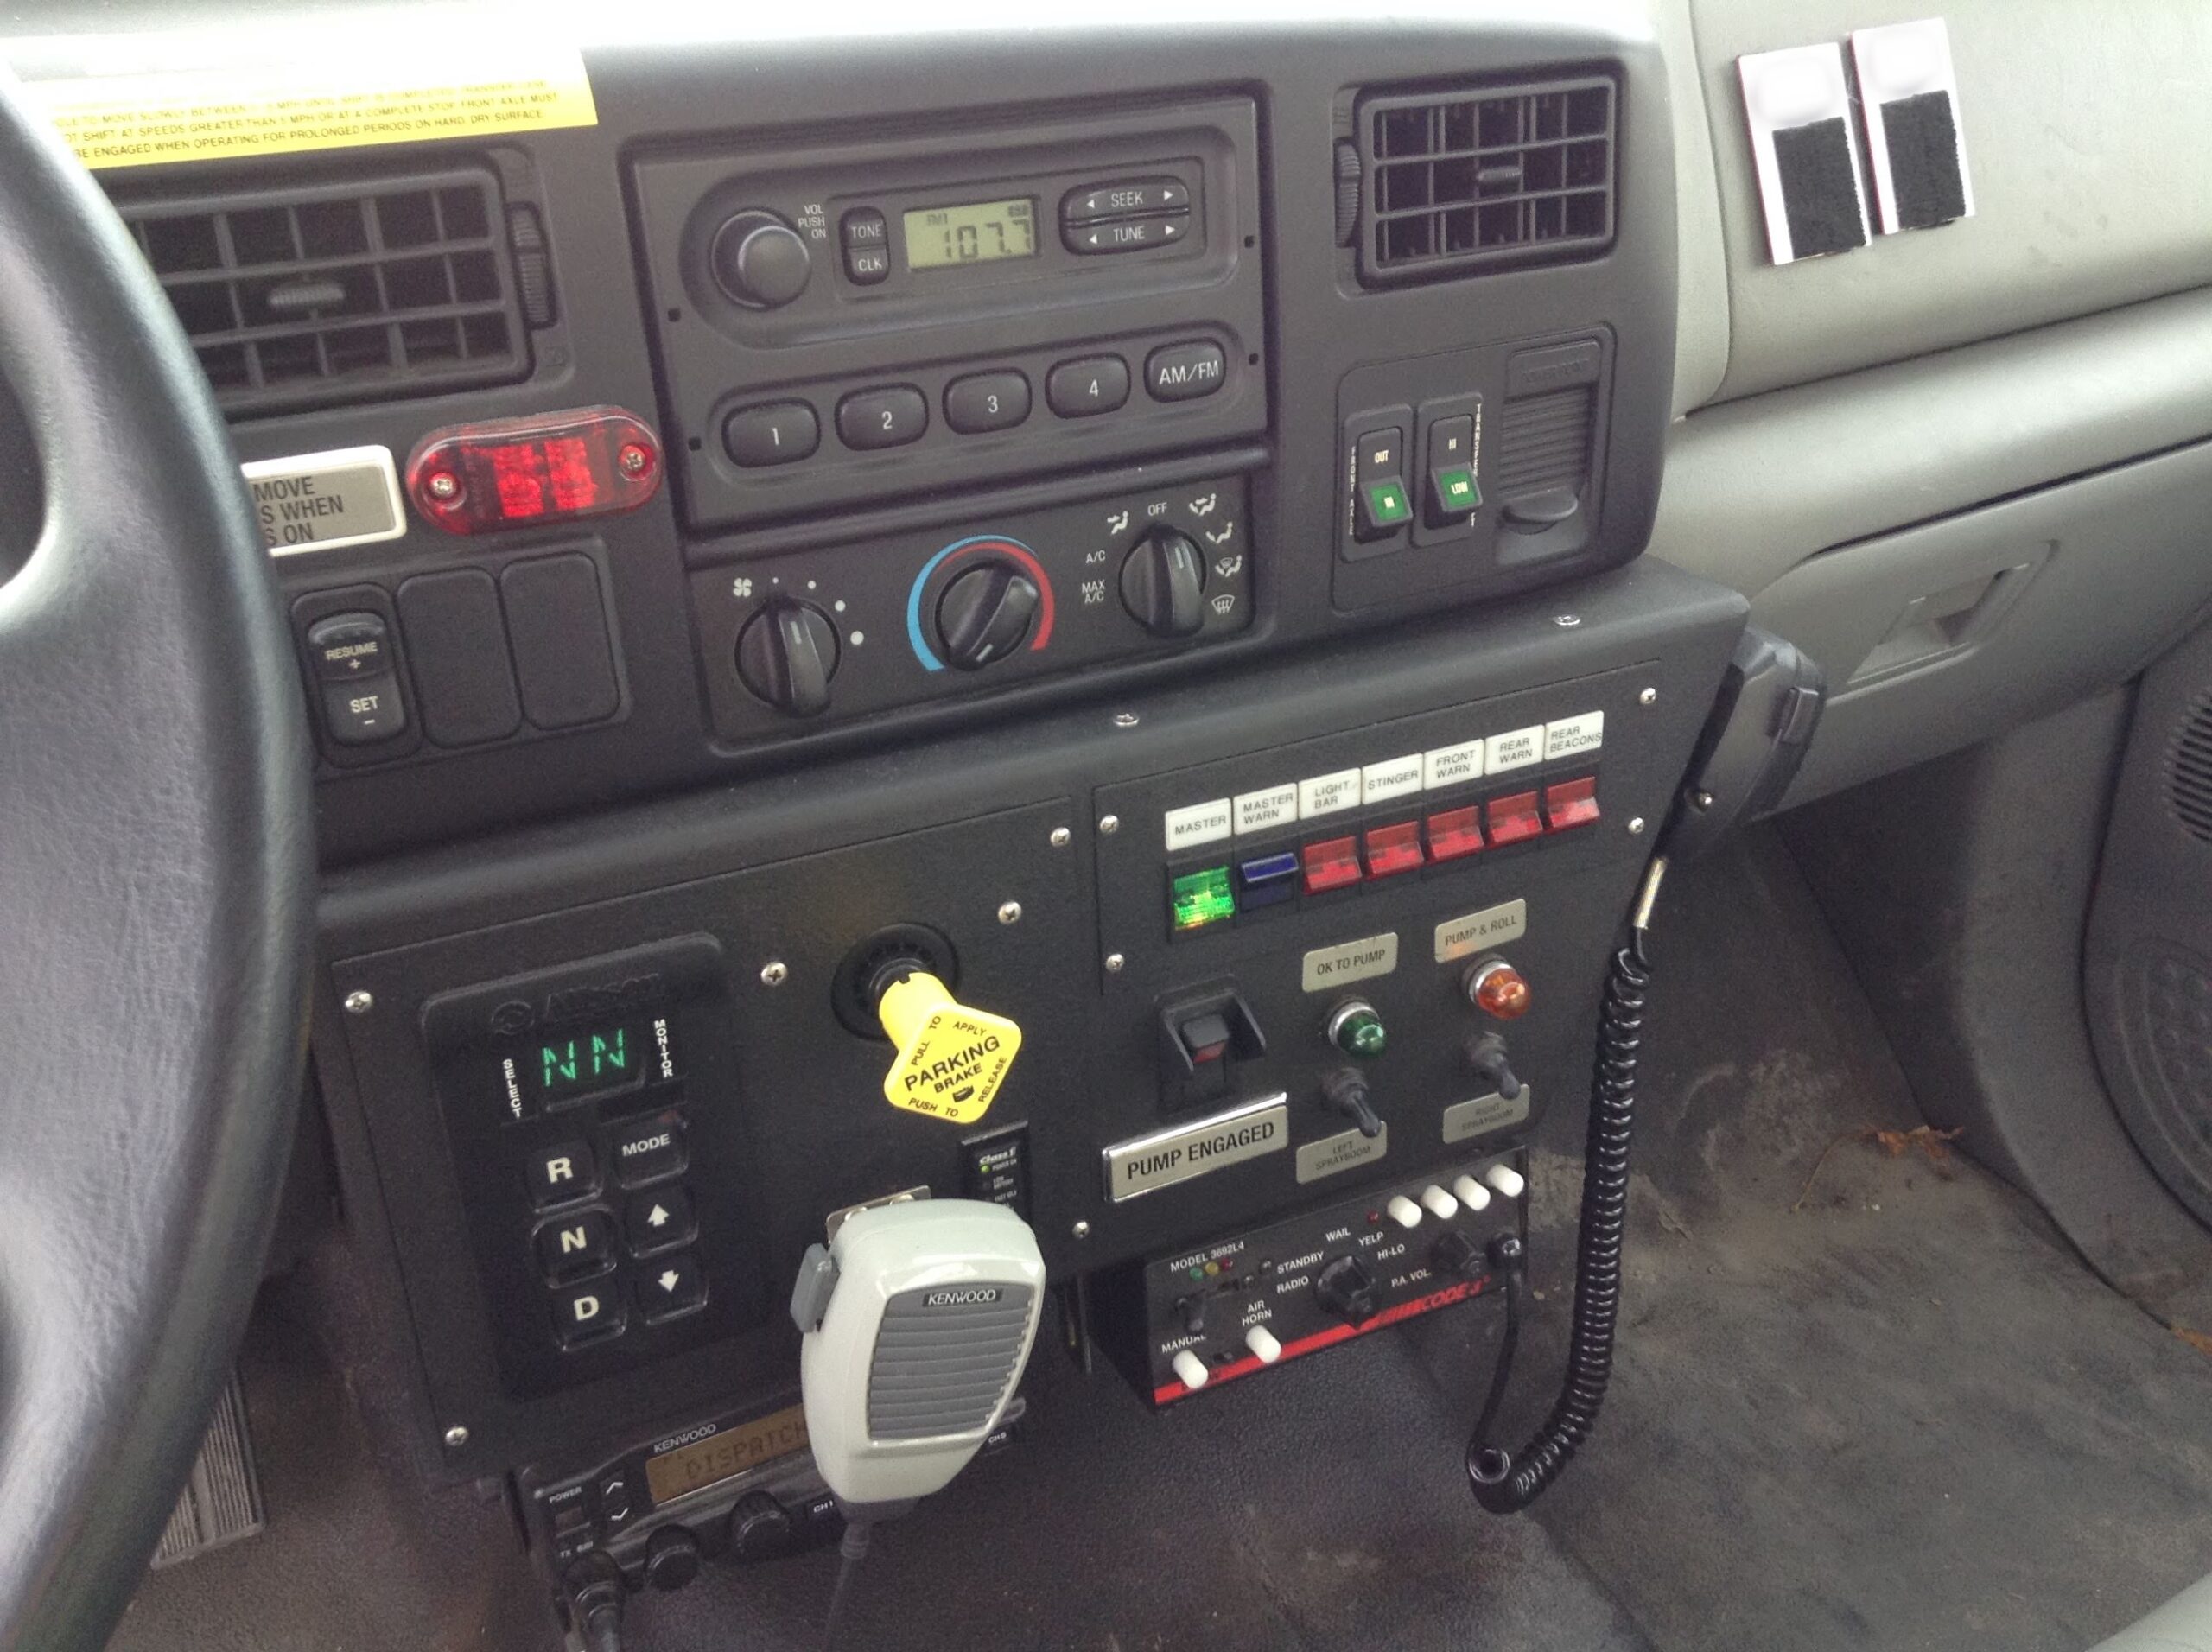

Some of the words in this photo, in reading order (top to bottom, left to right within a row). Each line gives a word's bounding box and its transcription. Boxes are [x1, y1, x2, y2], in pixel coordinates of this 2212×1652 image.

[84, 129, 116, 142] SHIFT
[139, 124, 187, 137] SPEEDS
[189, 118, 243, 133] GREATER
[247, 117, 276, 128] THAN
[94, 142, 153, 158] ENGAGED
[155, 139, 191, 153] WHEN
[194, 133, 260, 150] OPERATING
[263, 130, 287, 143] FOR
[289, 125, 361, 140] PROLONGED
[363, 120, 412, 133] PERIODS
[416, 118, 432, 130] ON
[471, 113, 491, 125] DRY
[494, 109, 543, 123] SURFACE
[1111, 190, 1143, 208] SEEK
[804, 203, 823, 215] VOL
[798, 216, 826, 229] PUSH
[851, 222, 882, 239] TONE
[810, 228, 827, 239] ON
[1113, 225, 1145, 243] TUNE
[859, 258, 883, 272] CLK
[1159, 360, 1219, 387] AM/FM
[1088, 378, 1100, 398] 4
[988, 395, 999, 414] 3
[881, 411, 893, 430] 2
[772, 427, 779, 446] 1
[1374, 448, 1389, 464] OUT
[252, 475, 316, 502] MOVE
[279, 494, 345, 521] WHEN
[1147, 501, 1168, 517] OFF
[283, 522, 314, 544] ON
[1086, 550, 1106, 565] A/C
[1082, 579, 1106, 594] MAX
[1084, 590, 1105, 604] A/C
[325, 640, 378, 662] RESUME
[350, 695, 378, 714] SET
[1550, 725, 1580, 740] REAR
[1499, 737, 1530, 752] REAR
[1549, 732, 1603, 753] BEACONS
[1435, 750, 1475, 767] FRONT
[1499, 748, 1533, 765] WARN
[1368, 769, 1419, 791] STINGER
[1436, 764, 1471, 779] WARN
[1314, 780, 1349, 797] LIGHT
[1243, 792, 1294, 813] MASTER
[1314, 794, 1338, 807] BAR
[1175, 815, 1227, 836] MASTER
[1243, 808, 1281, 825] WARN
[1445, 929, 1476, 948] PUMP
[1478, 924, 1488, 937] &
[1491, 915, 1518, 932] ROLL
[1317, 961, 1333, 976] OK
[1335, 956, 1351, 970] TO
[1352, 948, 1385, 967] PUMP
[653, 1018, 674, 1078] MONITOR
[911, 1039, 931, 1066] PULL
[928, 1015, 942, 1031] TO
[952, 1020, 987, 1037] APPLY
[904, 1035, 1001, 1091] PARKING
[502, 1058, 523, 1118] SELECT
[908, 1097, 938, 1113] PUSH
[944, 1106, 959, 1118] TO
[978, 1056, 1008, 1102] RELEASE
[933, 1063, 983, 1094] BRAKE
[621, 1132, 671, 1158] MODE
[1127, 1149, 1183, 1180] PUMP
[1187, 1122, 1276, 1162] ENGAGED
[1332, 1141, 1353, 1154] LEFT
[546, 1156, 574, 1184] R
[560, 1225, 588, 1254] N
[1325, 1227, 1351, 1242] WAIL
[1358, 1231, 1384, 1247] YELP
[1377, 1243, 1405, 1261] HI-LO
[1170, 1253, 1209, 1273] MODEL
[1277, 1251, 1325, 1274] STANDBY
[1276, 1275, 1309, 1294] RADIO
[927, 1288, 997, 1306] KENWOOD
[1247, 1299, 1266, 1313] AIR
[574, 1295, 600, 1321] D
[1242, 1308, 1273, 1327] HORN
[1161, 1334, 1207, 1353] MANUAL
[653, 1423, 717, 1453] KENWOOD
[549, 1486, 582, 1504] POWER
